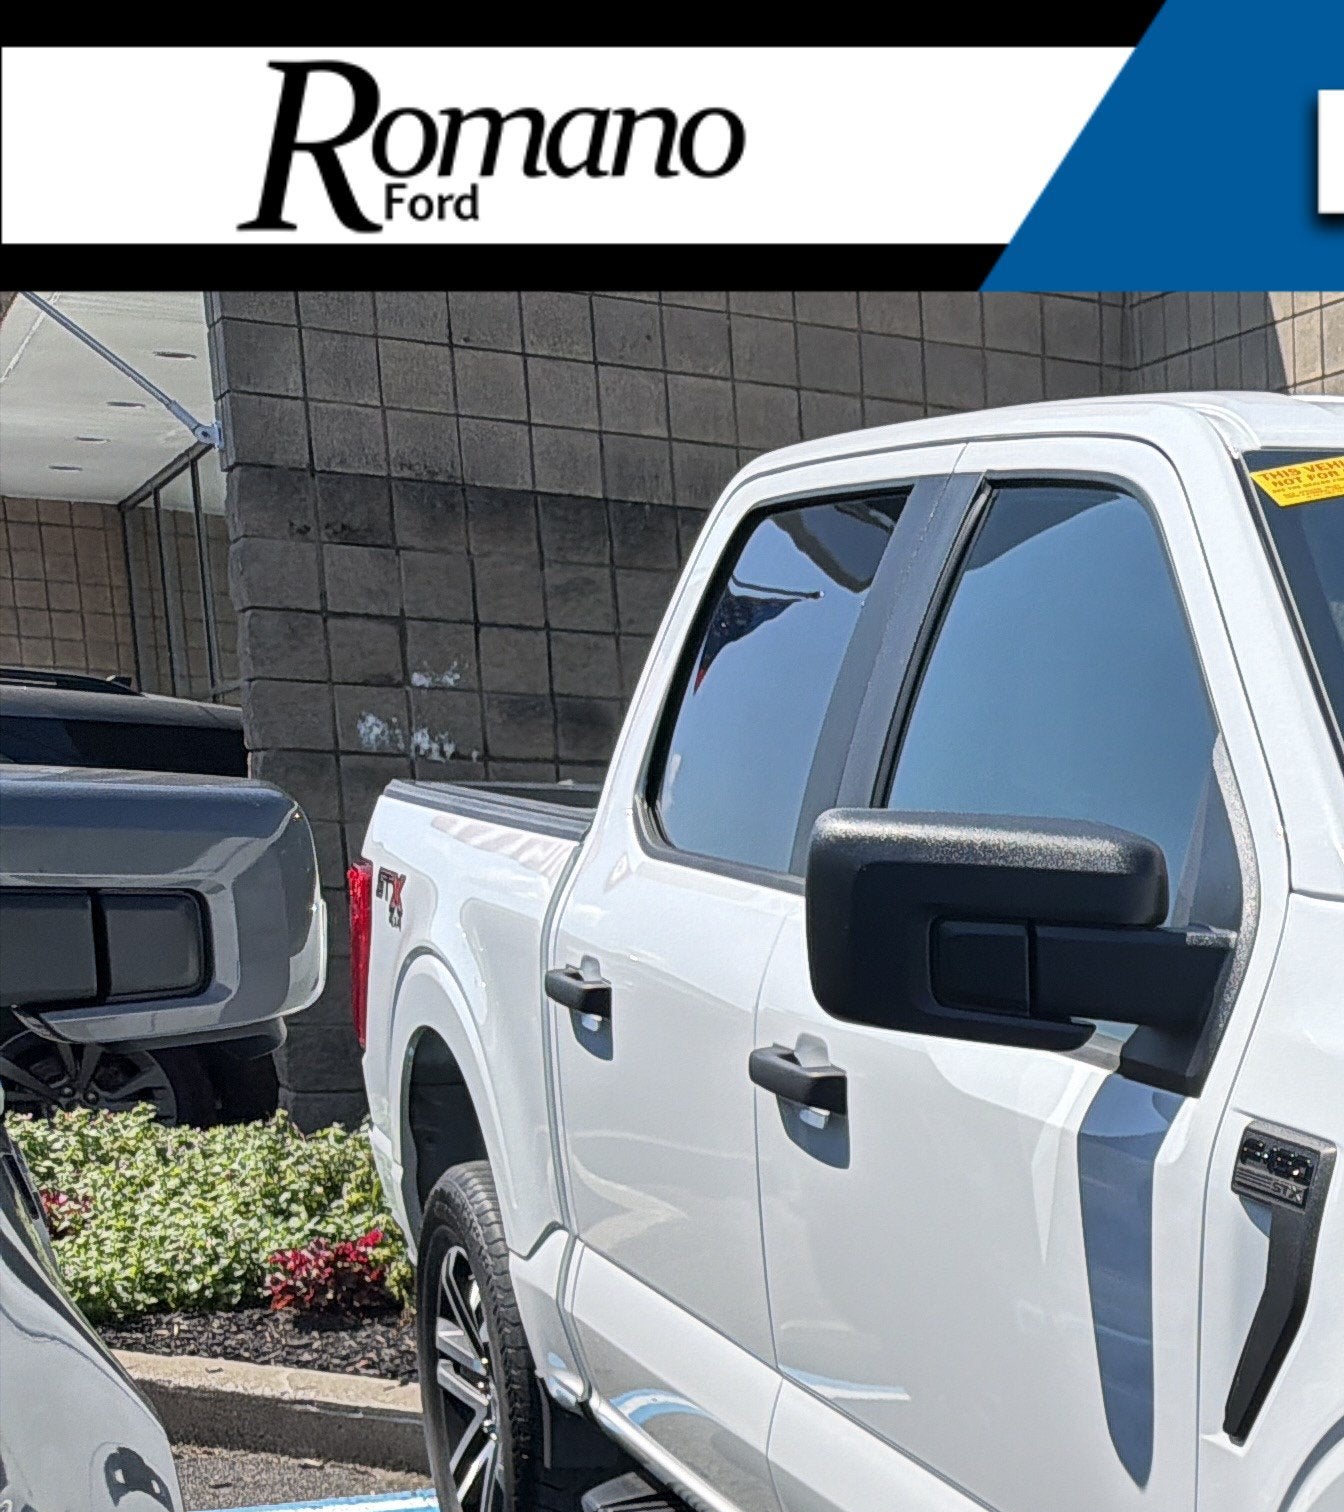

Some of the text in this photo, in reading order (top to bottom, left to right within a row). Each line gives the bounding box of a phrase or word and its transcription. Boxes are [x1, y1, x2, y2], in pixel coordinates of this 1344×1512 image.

[1257, 467, 1301, 482] THIS
[1271, 476, 1303, 488] NOT
[1307, 470, 1341, 481] FOR
